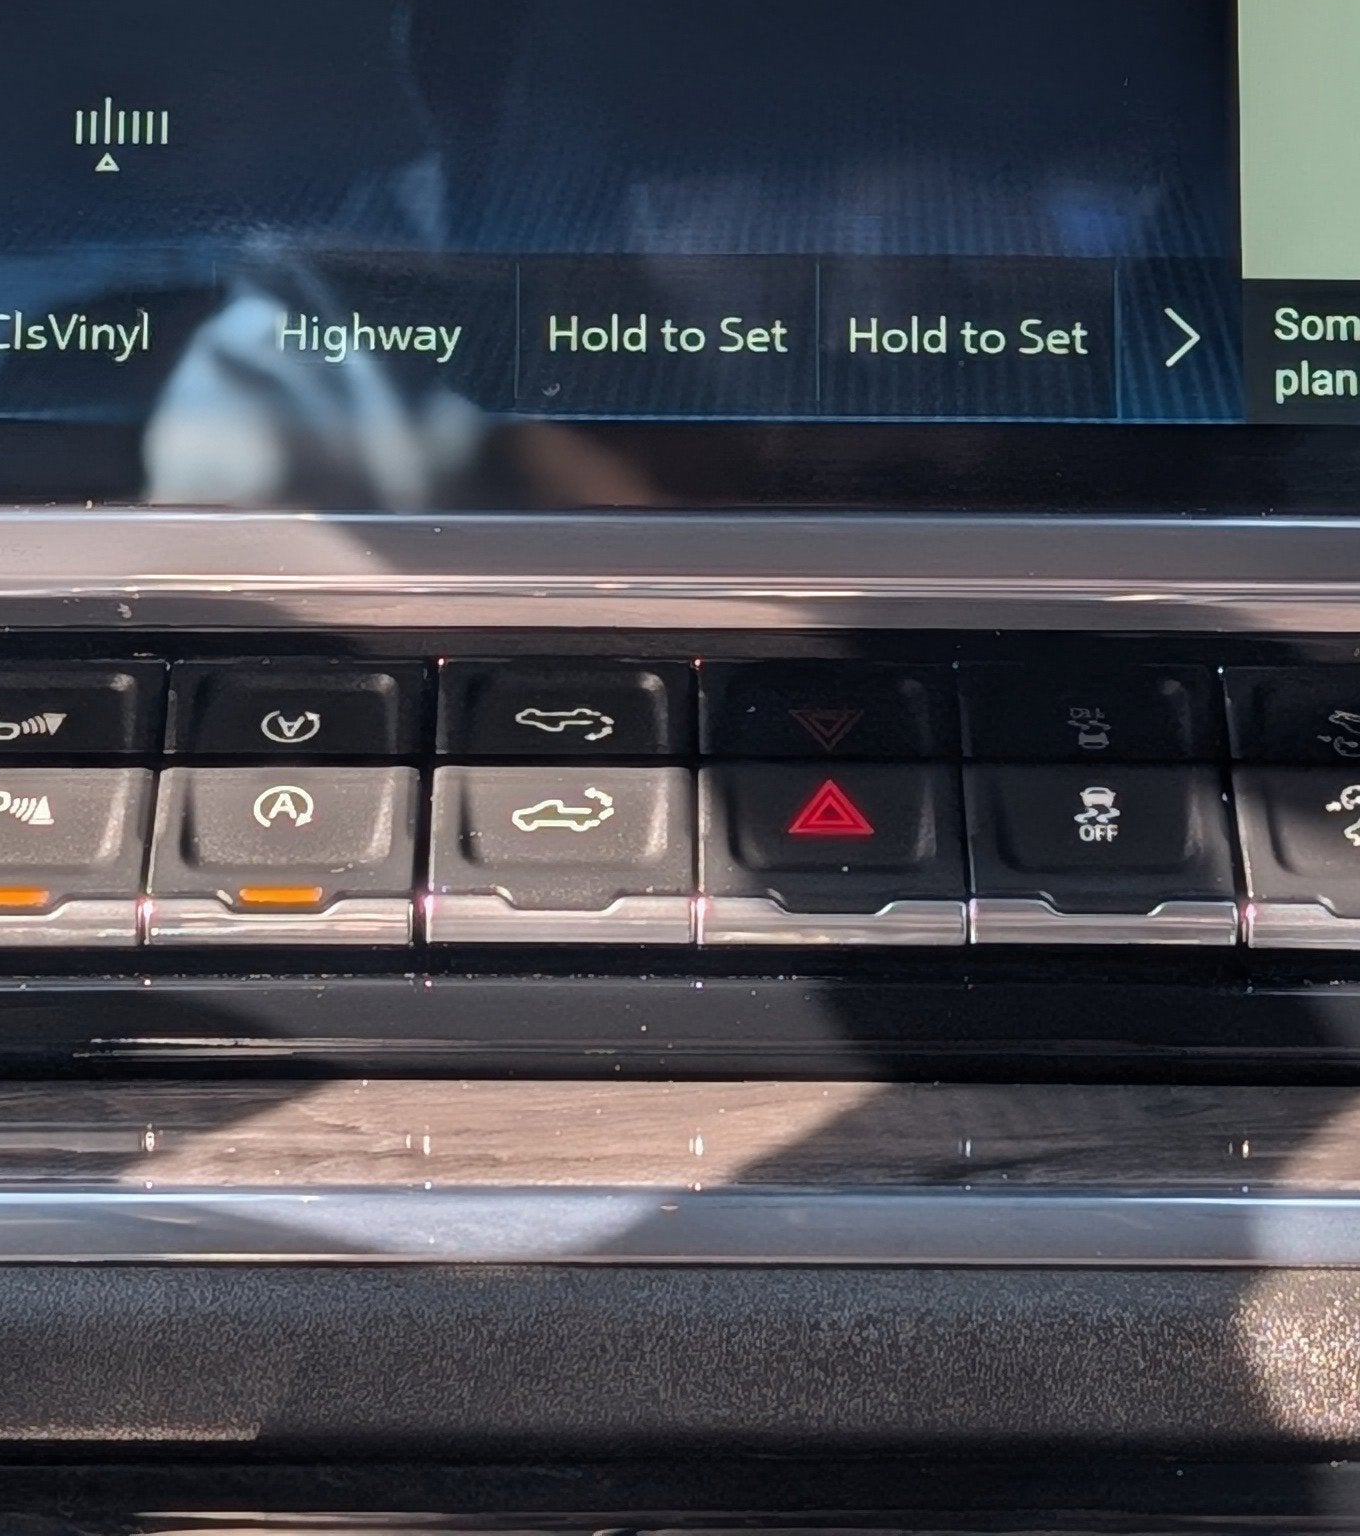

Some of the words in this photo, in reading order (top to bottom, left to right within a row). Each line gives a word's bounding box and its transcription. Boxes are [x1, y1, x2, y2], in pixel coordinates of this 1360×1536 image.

[276, 311, 462, 362] Highway
[549, 313, 647, 353] Hold
[660, 319, 706, 353] to
[718, 316, 788, 353] Set
[849, 315, 947, 354] Hold
[960, 321, 1006, 354] to
[1018, 318, 1088, 355] Set
[268, 793, 297, 819] A
[1078, 824, 1118, 842] OFF
